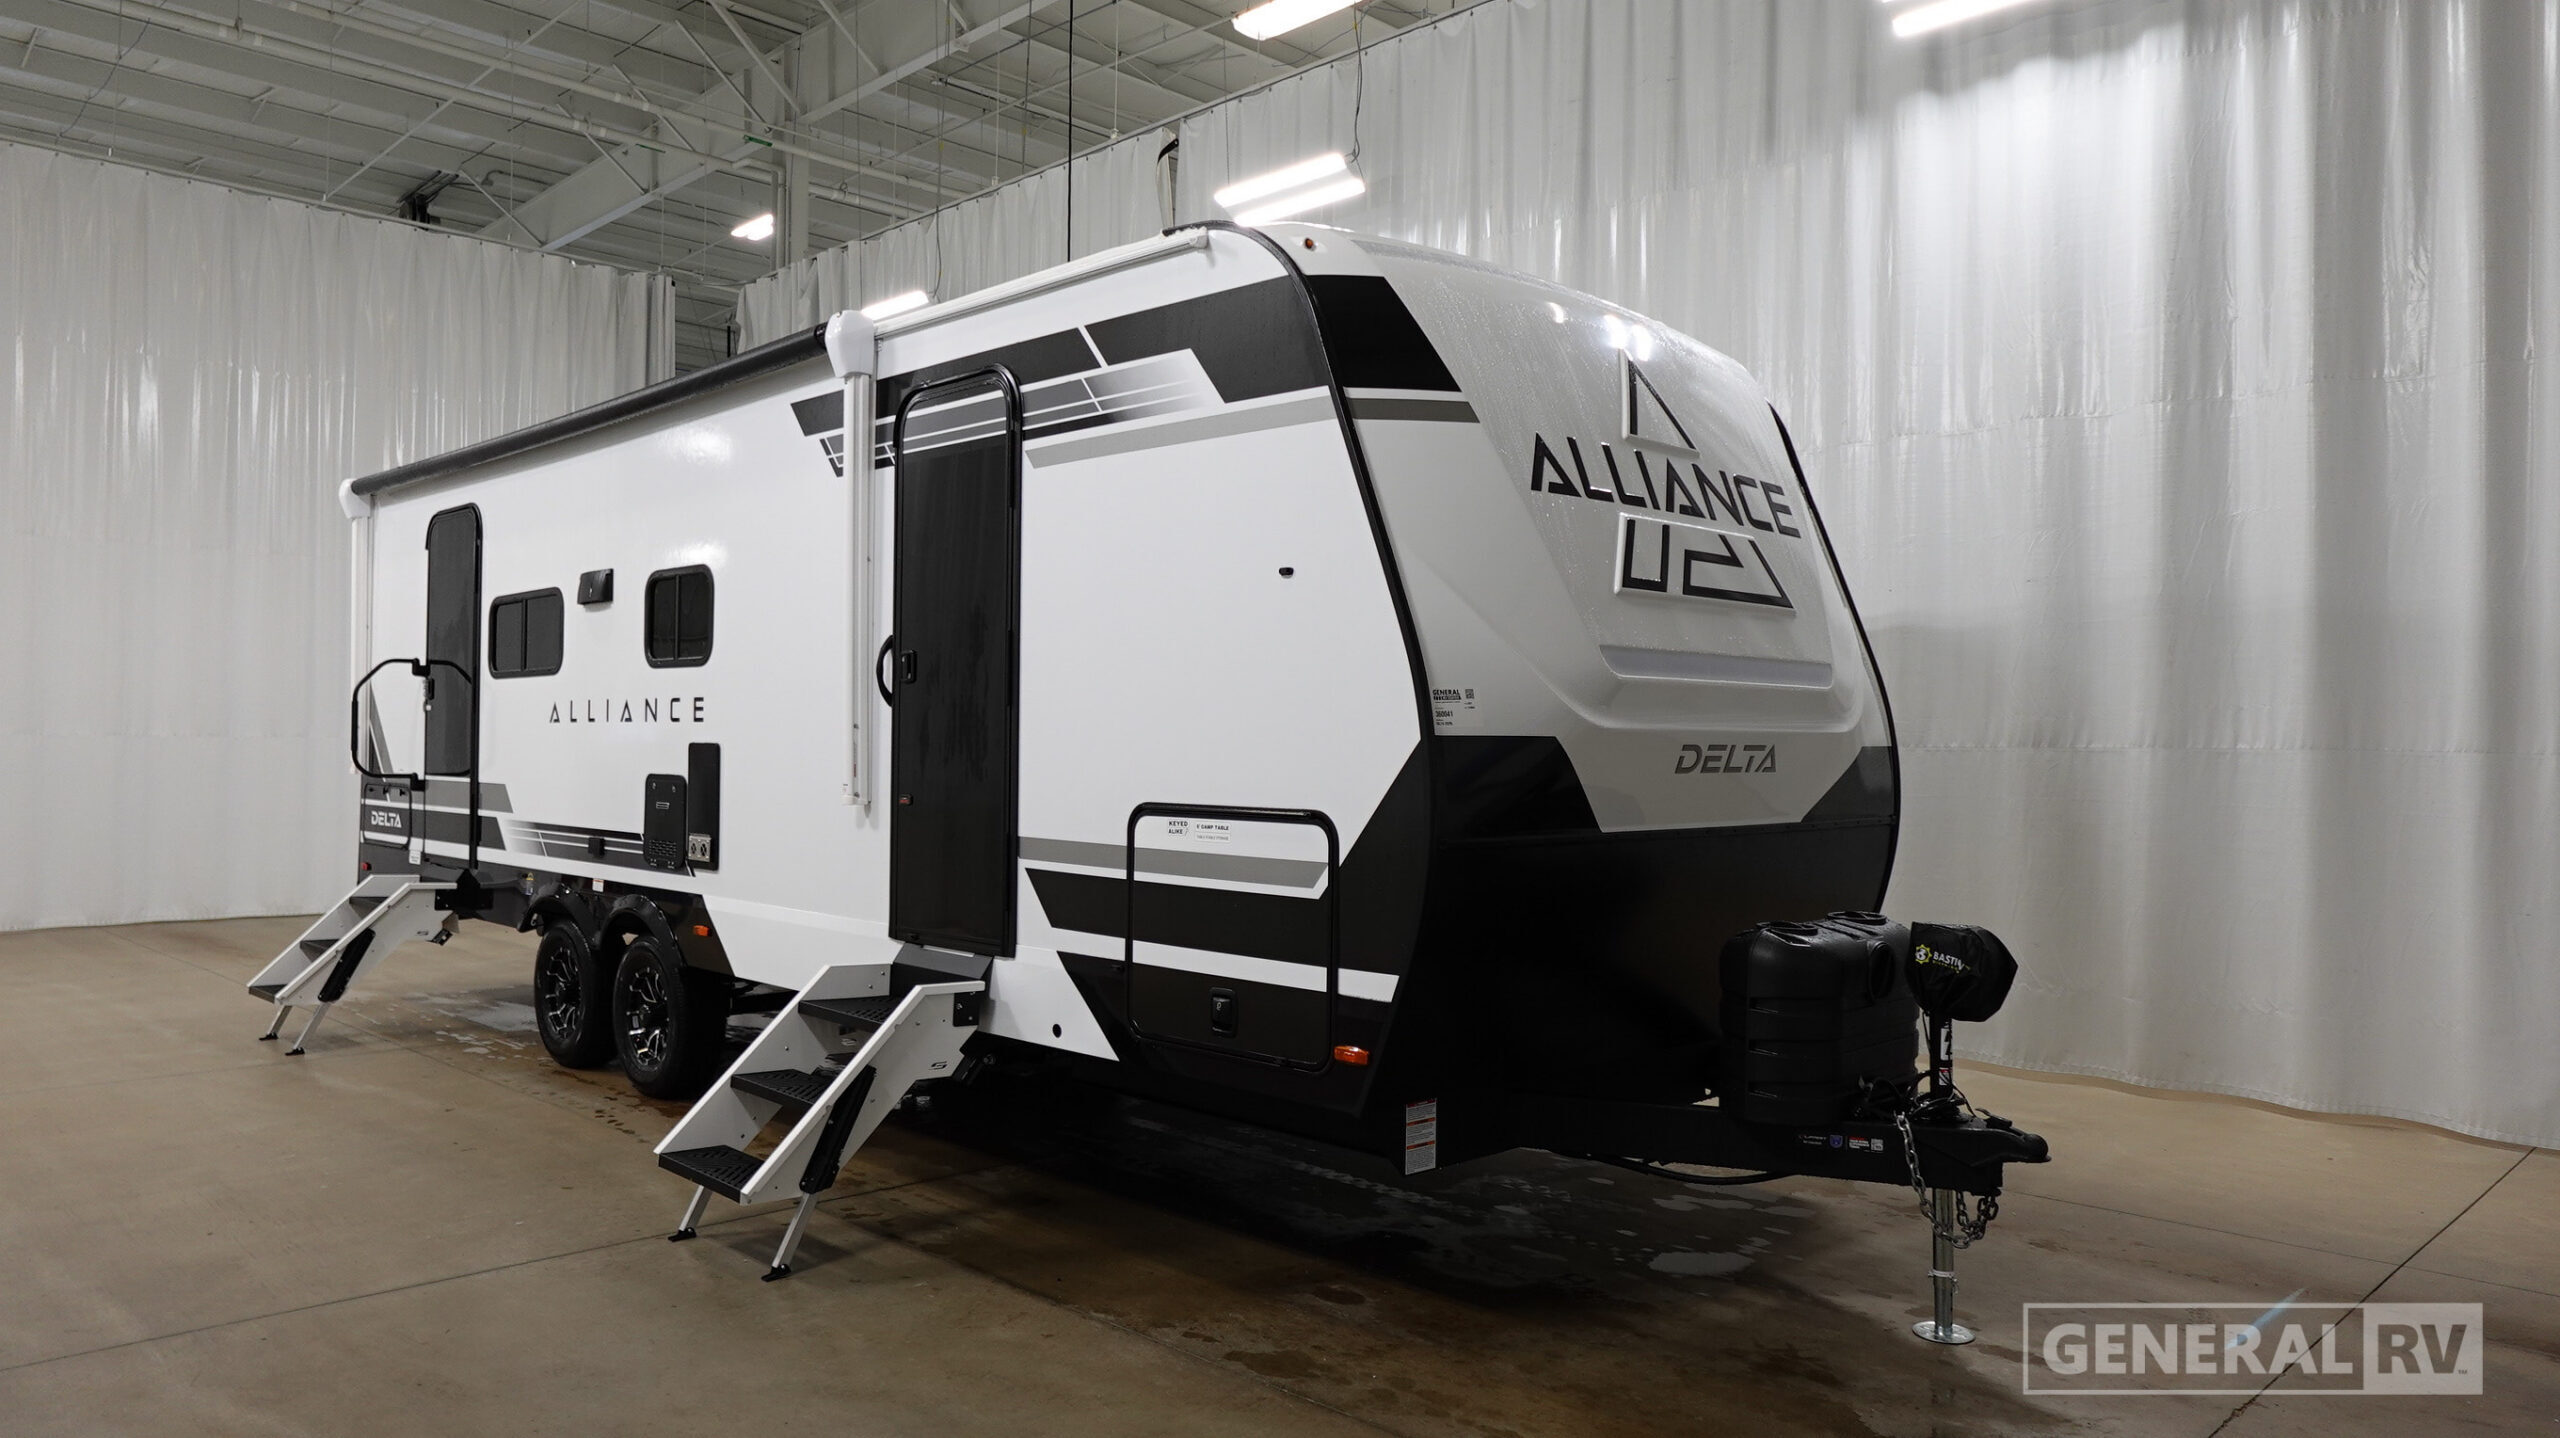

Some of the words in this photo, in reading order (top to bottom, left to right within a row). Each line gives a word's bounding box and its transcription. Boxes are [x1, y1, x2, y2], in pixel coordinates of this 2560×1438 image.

[1530, 432, 1801, 538] ALLIANCE
[549, 697, 704, 723] ALLIANCE
[1674, 743, 1777, 774] DELTA
[370, 810, 402, 828] DELTA
